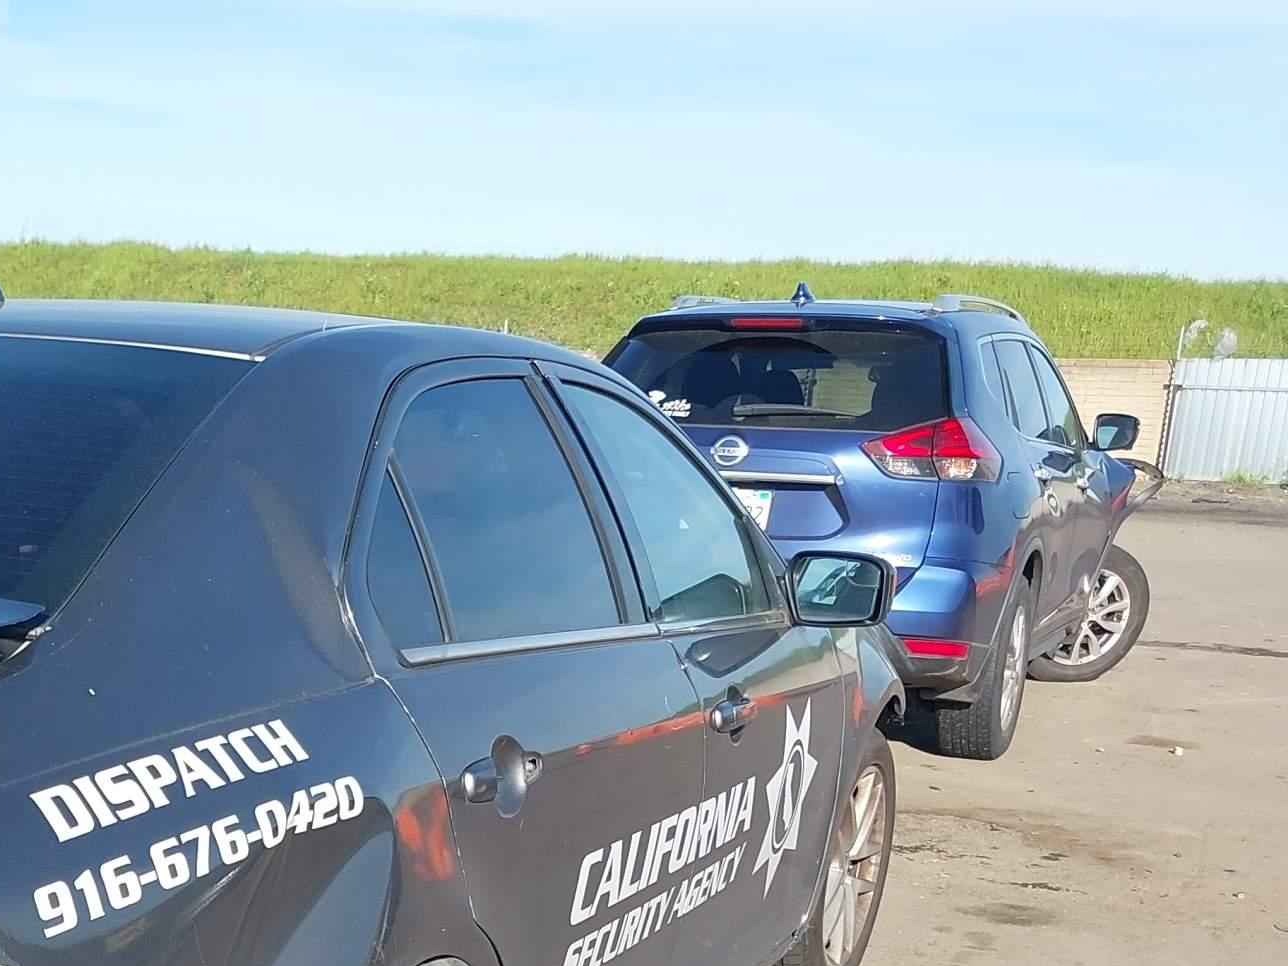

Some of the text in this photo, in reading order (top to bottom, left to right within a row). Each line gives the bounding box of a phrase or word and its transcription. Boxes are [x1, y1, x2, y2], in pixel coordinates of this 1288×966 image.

[29, 718, 311, 843] DISPATCH
[33, 775, 365, 939] 916-676-0420
[569, 775, 757, 926] CALIFORNIA
[667, 841, 747, 924] AGENCY
